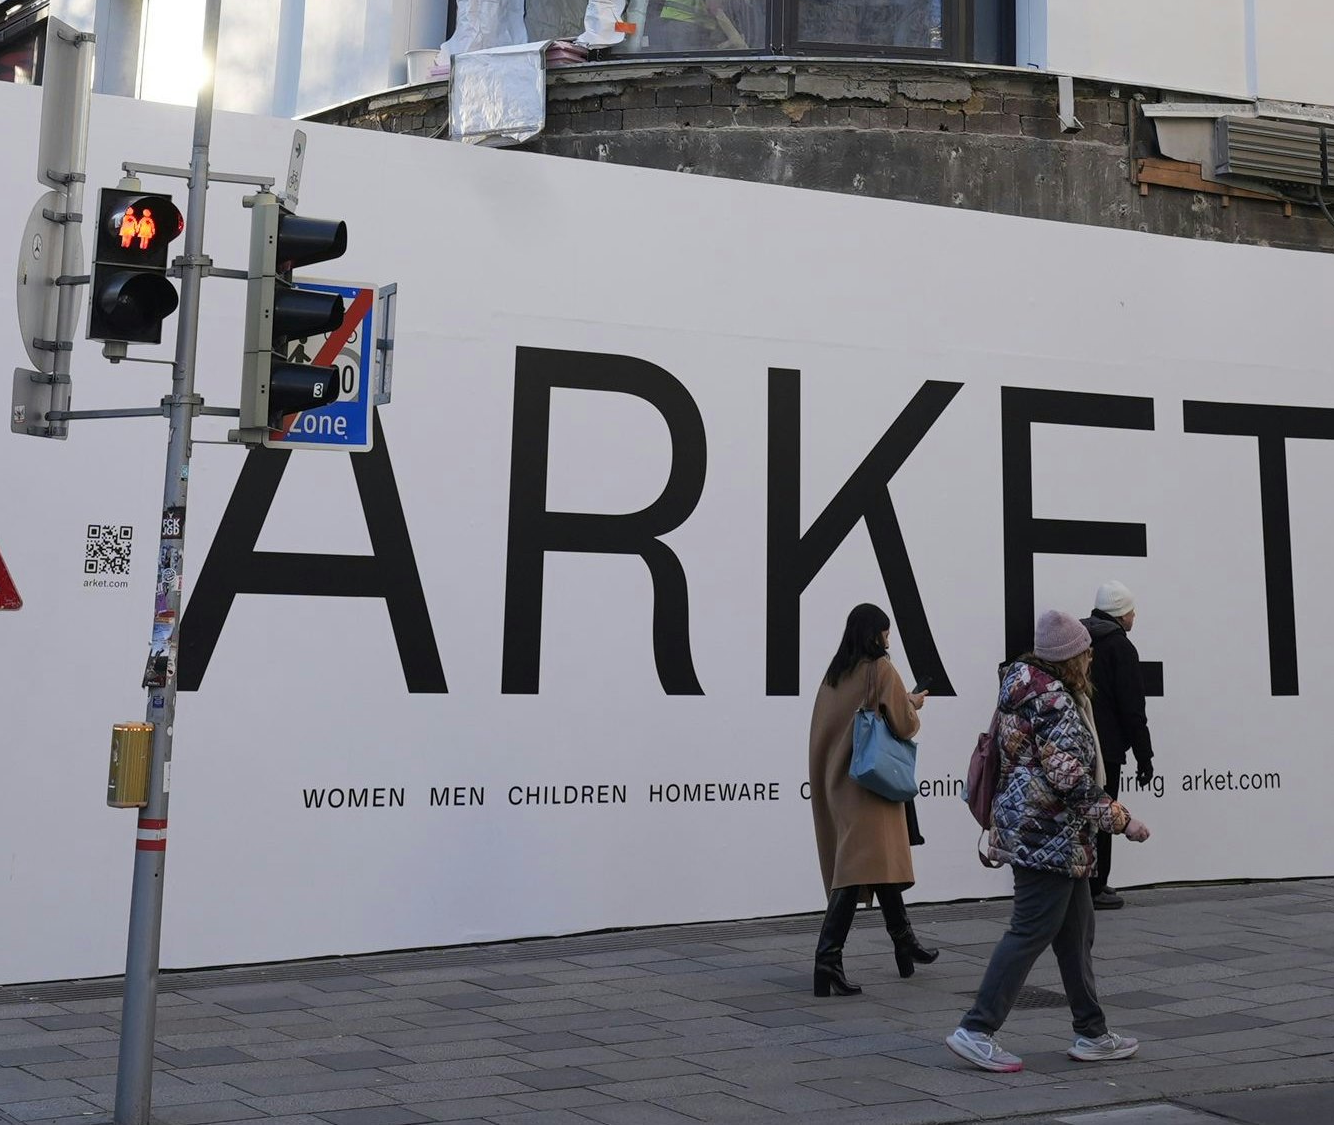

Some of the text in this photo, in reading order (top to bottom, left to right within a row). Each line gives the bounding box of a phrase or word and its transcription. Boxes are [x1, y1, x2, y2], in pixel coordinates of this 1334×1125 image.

[314, 384, 322, 397] 3
[289, 411, 348, 436] Zone
[162, 518, 181, 527] FCK
[162, 527, 180, 535] JGD
[83, 579, 128, 588] arket.com
[303, 787, 405, 808] WOMEN
[430, 786, 485, 807] MEN
[508, 784, 627, 805] CHILDREN
[649, 782, 779, 803] HOMEWARE
[1182, 768, 1281, 791] arket.com
